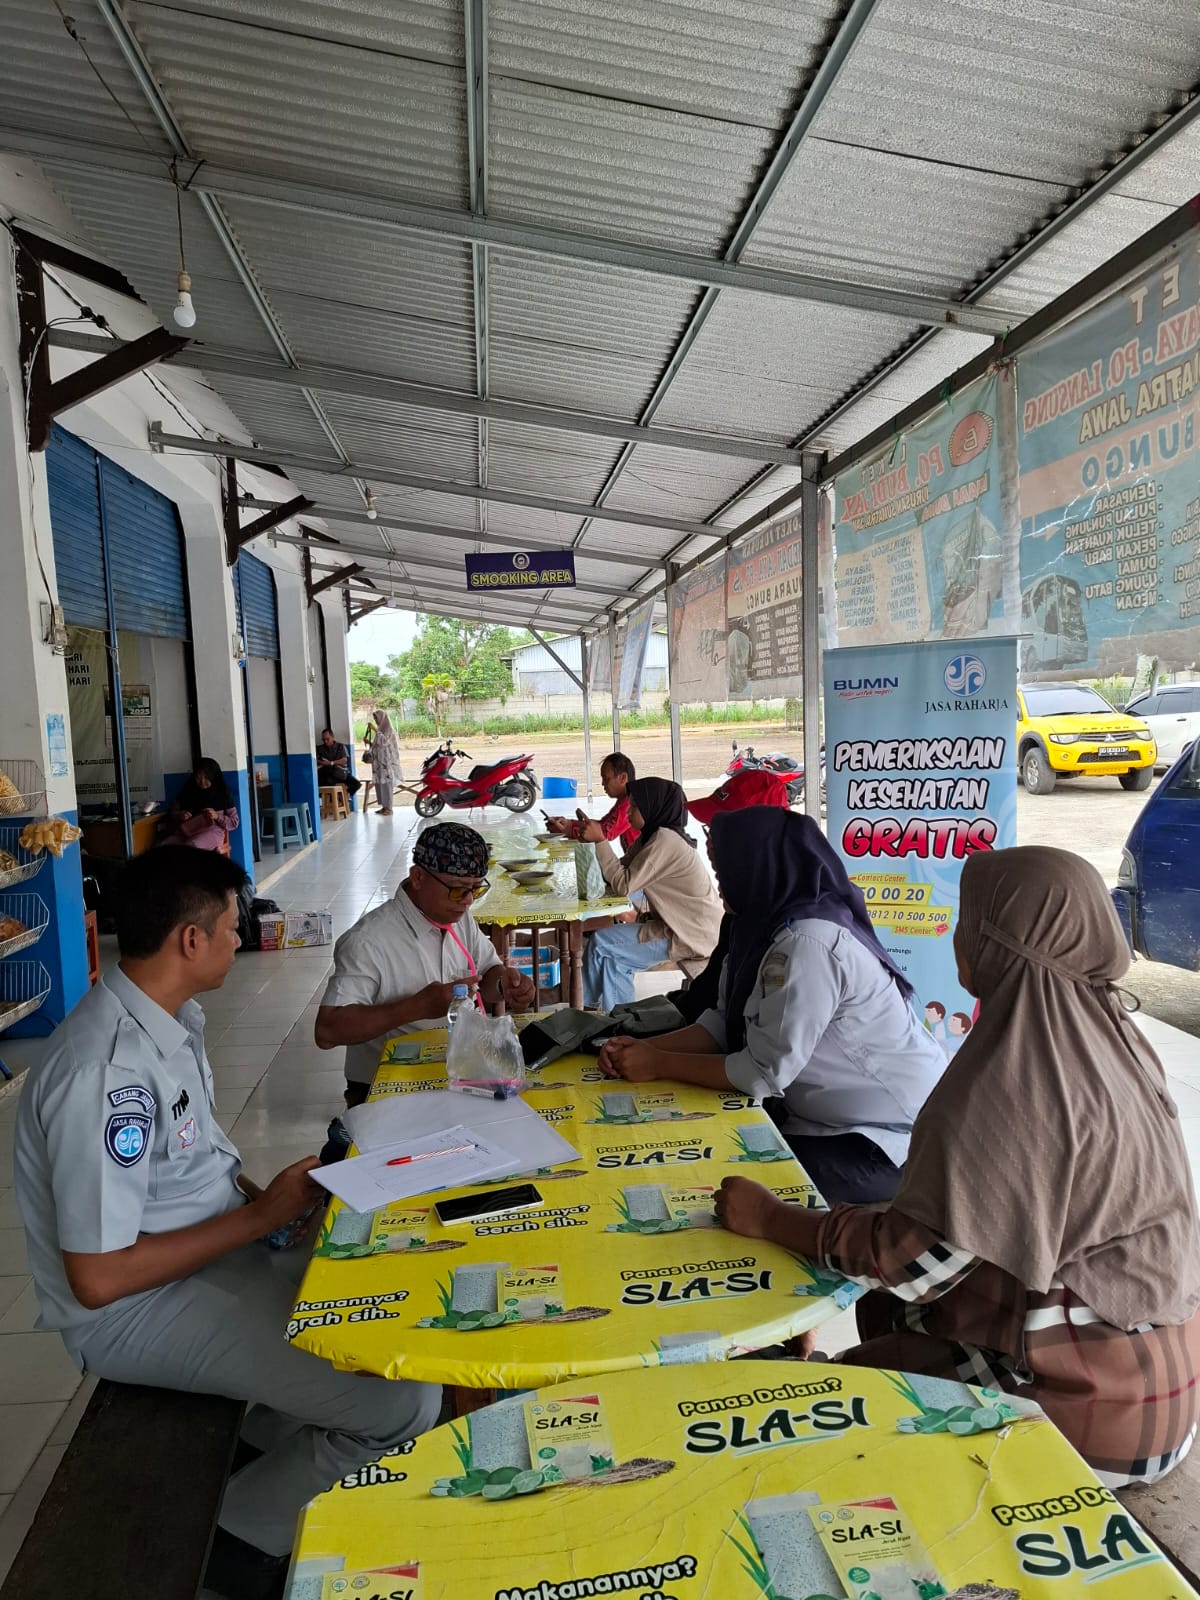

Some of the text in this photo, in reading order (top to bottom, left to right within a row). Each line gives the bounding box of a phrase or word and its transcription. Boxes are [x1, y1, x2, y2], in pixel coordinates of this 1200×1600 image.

[471, 569, 573, 586] SMOOKING AREA
[68, 664, 89, 673] HARI
[69, 676, 90, 685] HARI
[834, 677, 899, 690] BUMN
[925, 699, 1009, 713] JASA RAHARJA
[834, 737, 1005, 771] PEMERIKSAAN
[847, 778, 989, 810] KESEHATAN
[842, 817, 997, 859] GRATIS
[857, 874, 883, 882] Contact
[880, 887, 900, 900] 00
[904, 888, 925, 901] 20
[892, 910, 904, 920] 10
[907, 912, 925, 922] 500
[927, 913, 947, 922] 500
[894, 926, 932, 935] SMS Center
[723, 1098, 761, 1110] SL
[596, 1138, 703, 1154] Panas Dalam?
[597, 1147, 713, 1168] SLA-SI
[773, 1185, 814, 1196] Pana
[380, 1216, 427, 1226] SLA-SI
[475, 1217, 588, 1236] Serah sih..
[621, 1257, 757, 1281] Panas Dalam?
[504, 1276, 557, 1287] SLA-SI
[622, 1271, 772, 1305] SLA-SI
[347, 1307, 400, 1322] sih..
[678, 1378, 842, 1417] Panas Dalam?
[535, 1412, 599, 1429] SLA-SI
[686, 1397, 870, 1453] SLA-SI
[340, 1464, 407, 1488] sih..
[992, 1495, 1080, 1526] Panas
[832, 1520, 903, 1543] SLA-SI
[1016, 1514, 1151, 1576] SLA
[495, 1555, 698, 1600] Makanannya?
